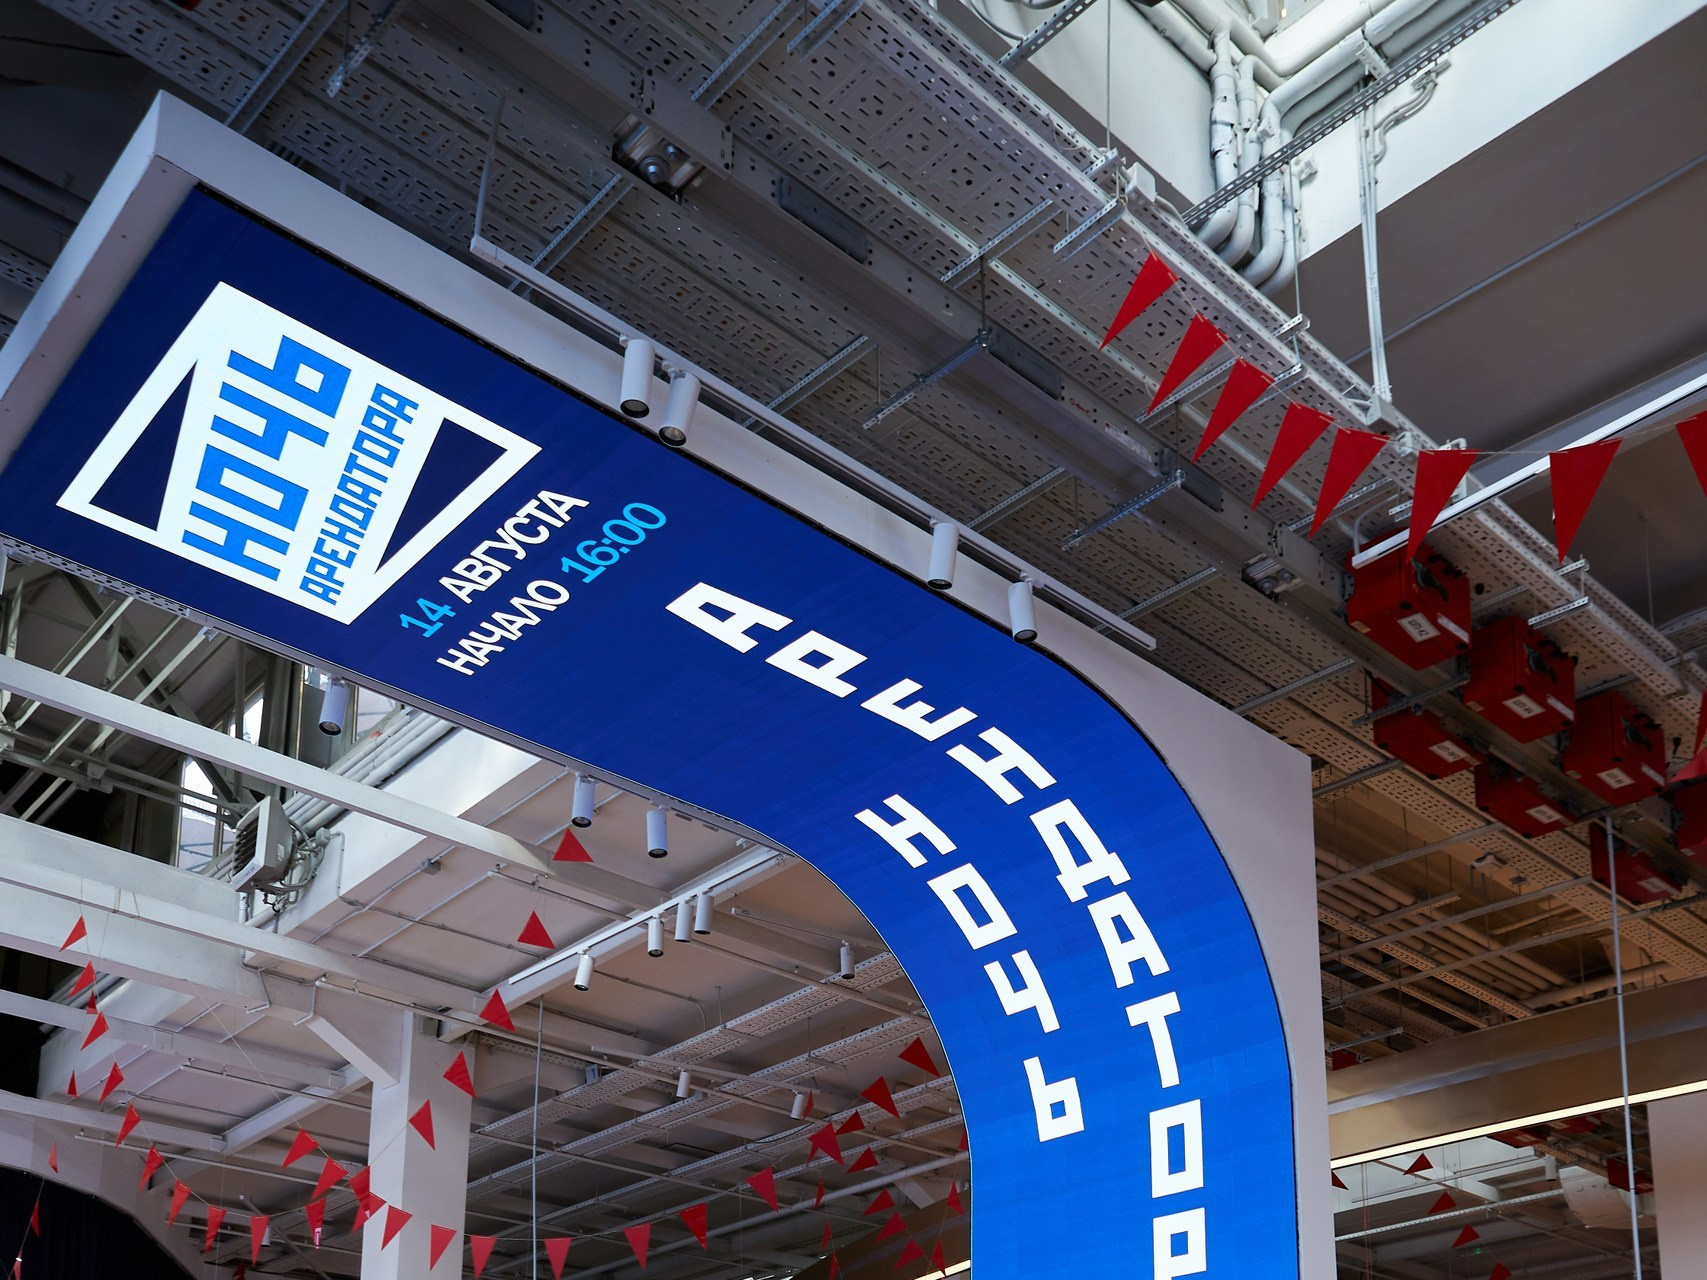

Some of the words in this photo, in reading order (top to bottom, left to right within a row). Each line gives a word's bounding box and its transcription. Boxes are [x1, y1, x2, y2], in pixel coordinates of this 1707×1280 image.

[181, 334, 352, 581] НОЧЬ
[299, 382, 420, 606] АРЕНДАТОРА
[399, 596, 456, 638] 14
[438, 489, 590, 604] АВГУСТА
[436, 579, 571, 677] НАЧАЛО
[561, 501, 668, 584] 16:00
[854, 793, 1085, 1142] НОЧЬ
